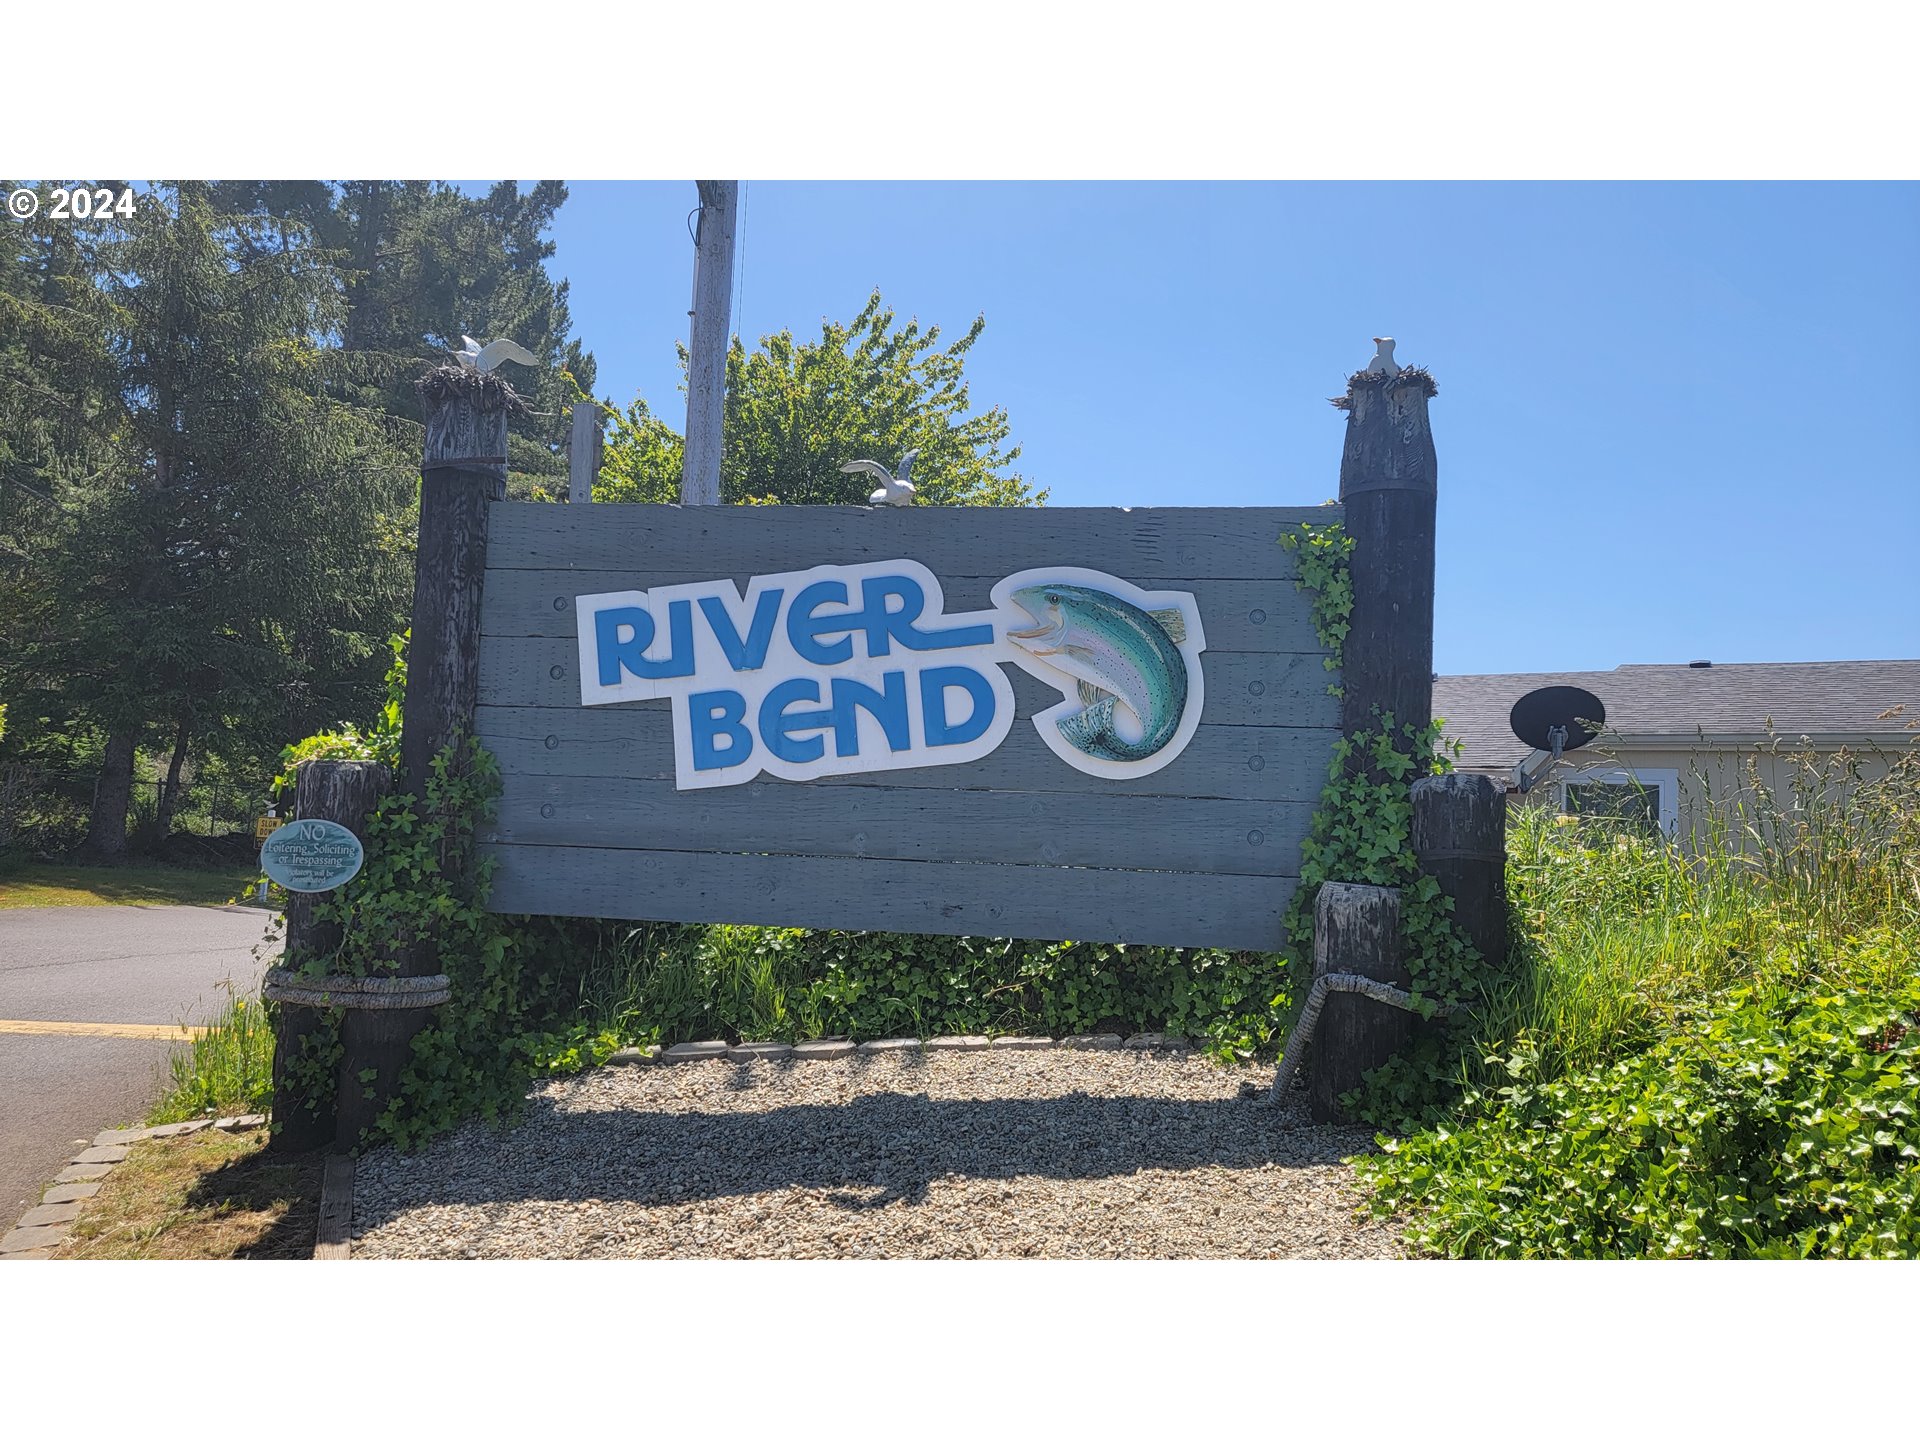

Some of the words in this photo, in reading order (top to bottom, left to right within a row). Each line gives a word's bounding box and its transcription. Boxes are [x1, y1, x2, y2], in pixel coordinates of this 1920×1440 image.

[594, 575, 994, 686] RIVER
[688, 665, 996, 771] BEND
[300, 824, 325, 841] NO
[268, 842, 310, 855] Loitering,
[314, 842, 355, 857] Soliciting
[278, 856, 289, 864] or
[292, 854, 342, 868] Trespassing
